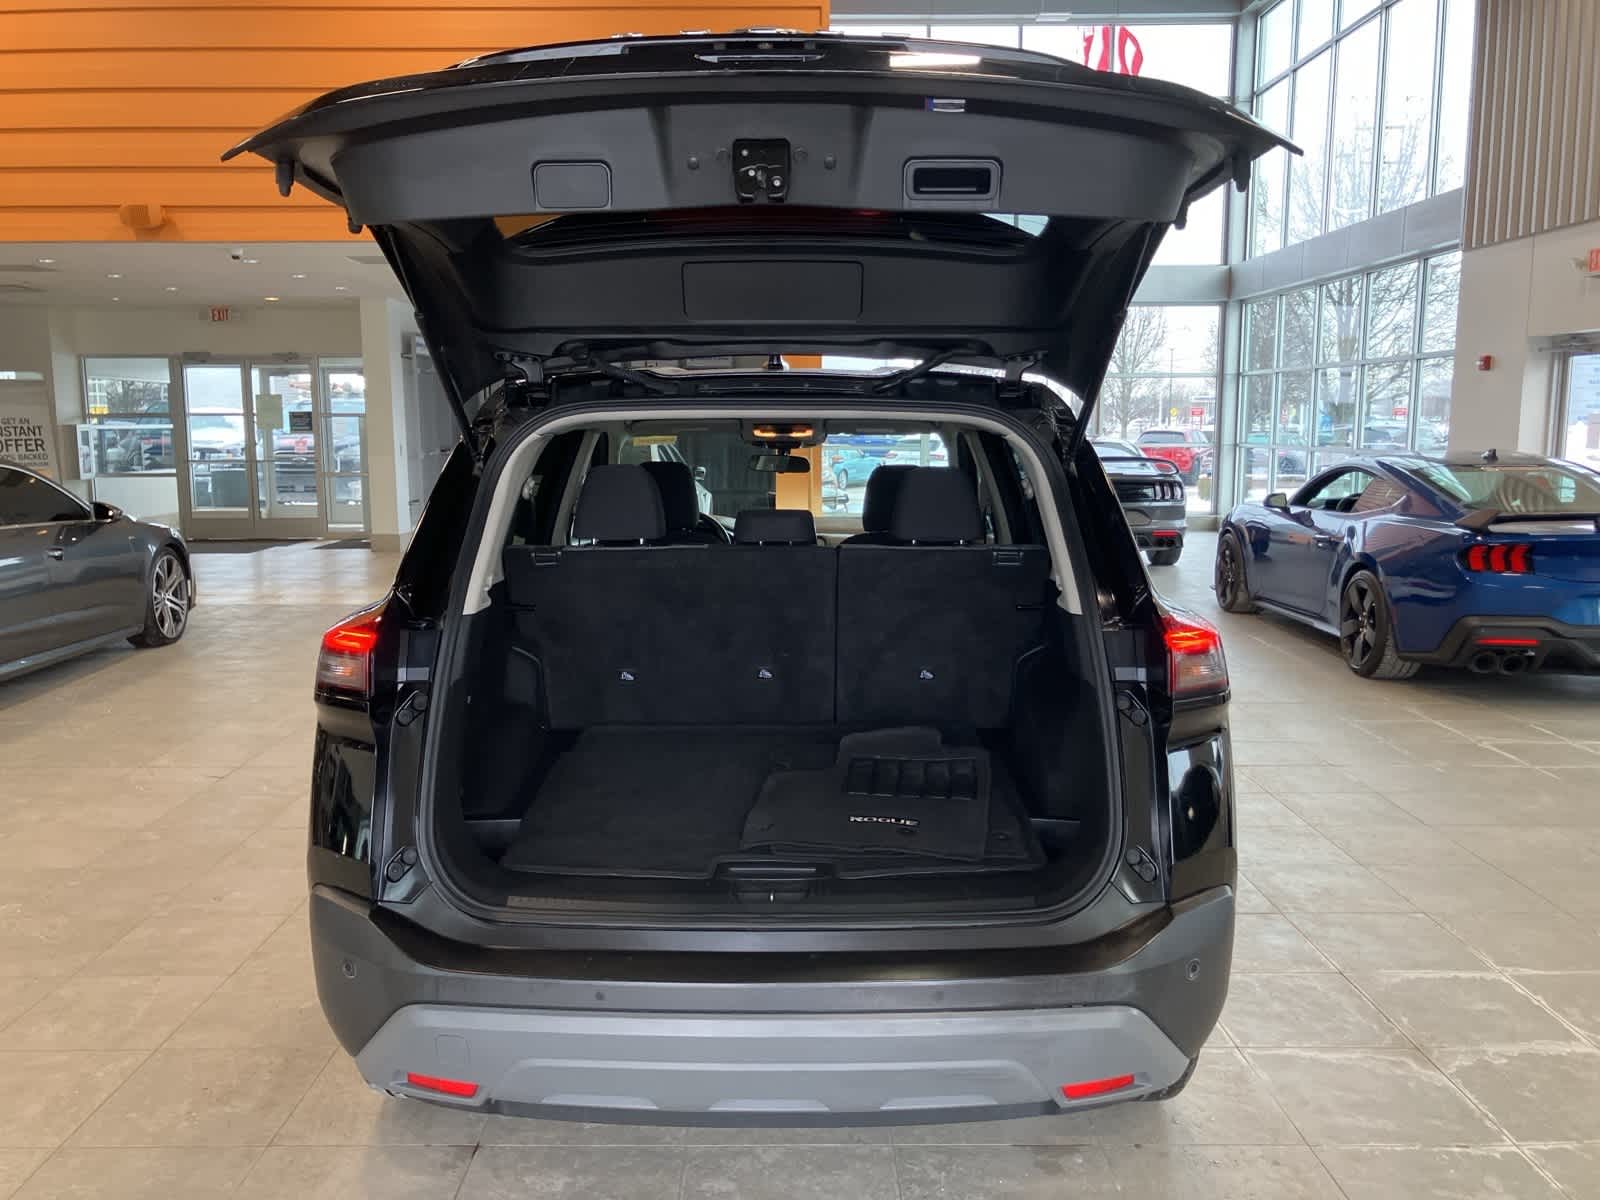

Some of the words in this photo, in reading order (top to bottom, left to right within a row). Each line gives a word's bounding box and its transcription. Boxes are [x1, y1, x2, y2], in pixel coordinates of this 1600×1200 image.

[211, 307, 229, 321] EXIT
[1, 417, 16, 425] GET
[849, 816, 919, 826] ROGUE
